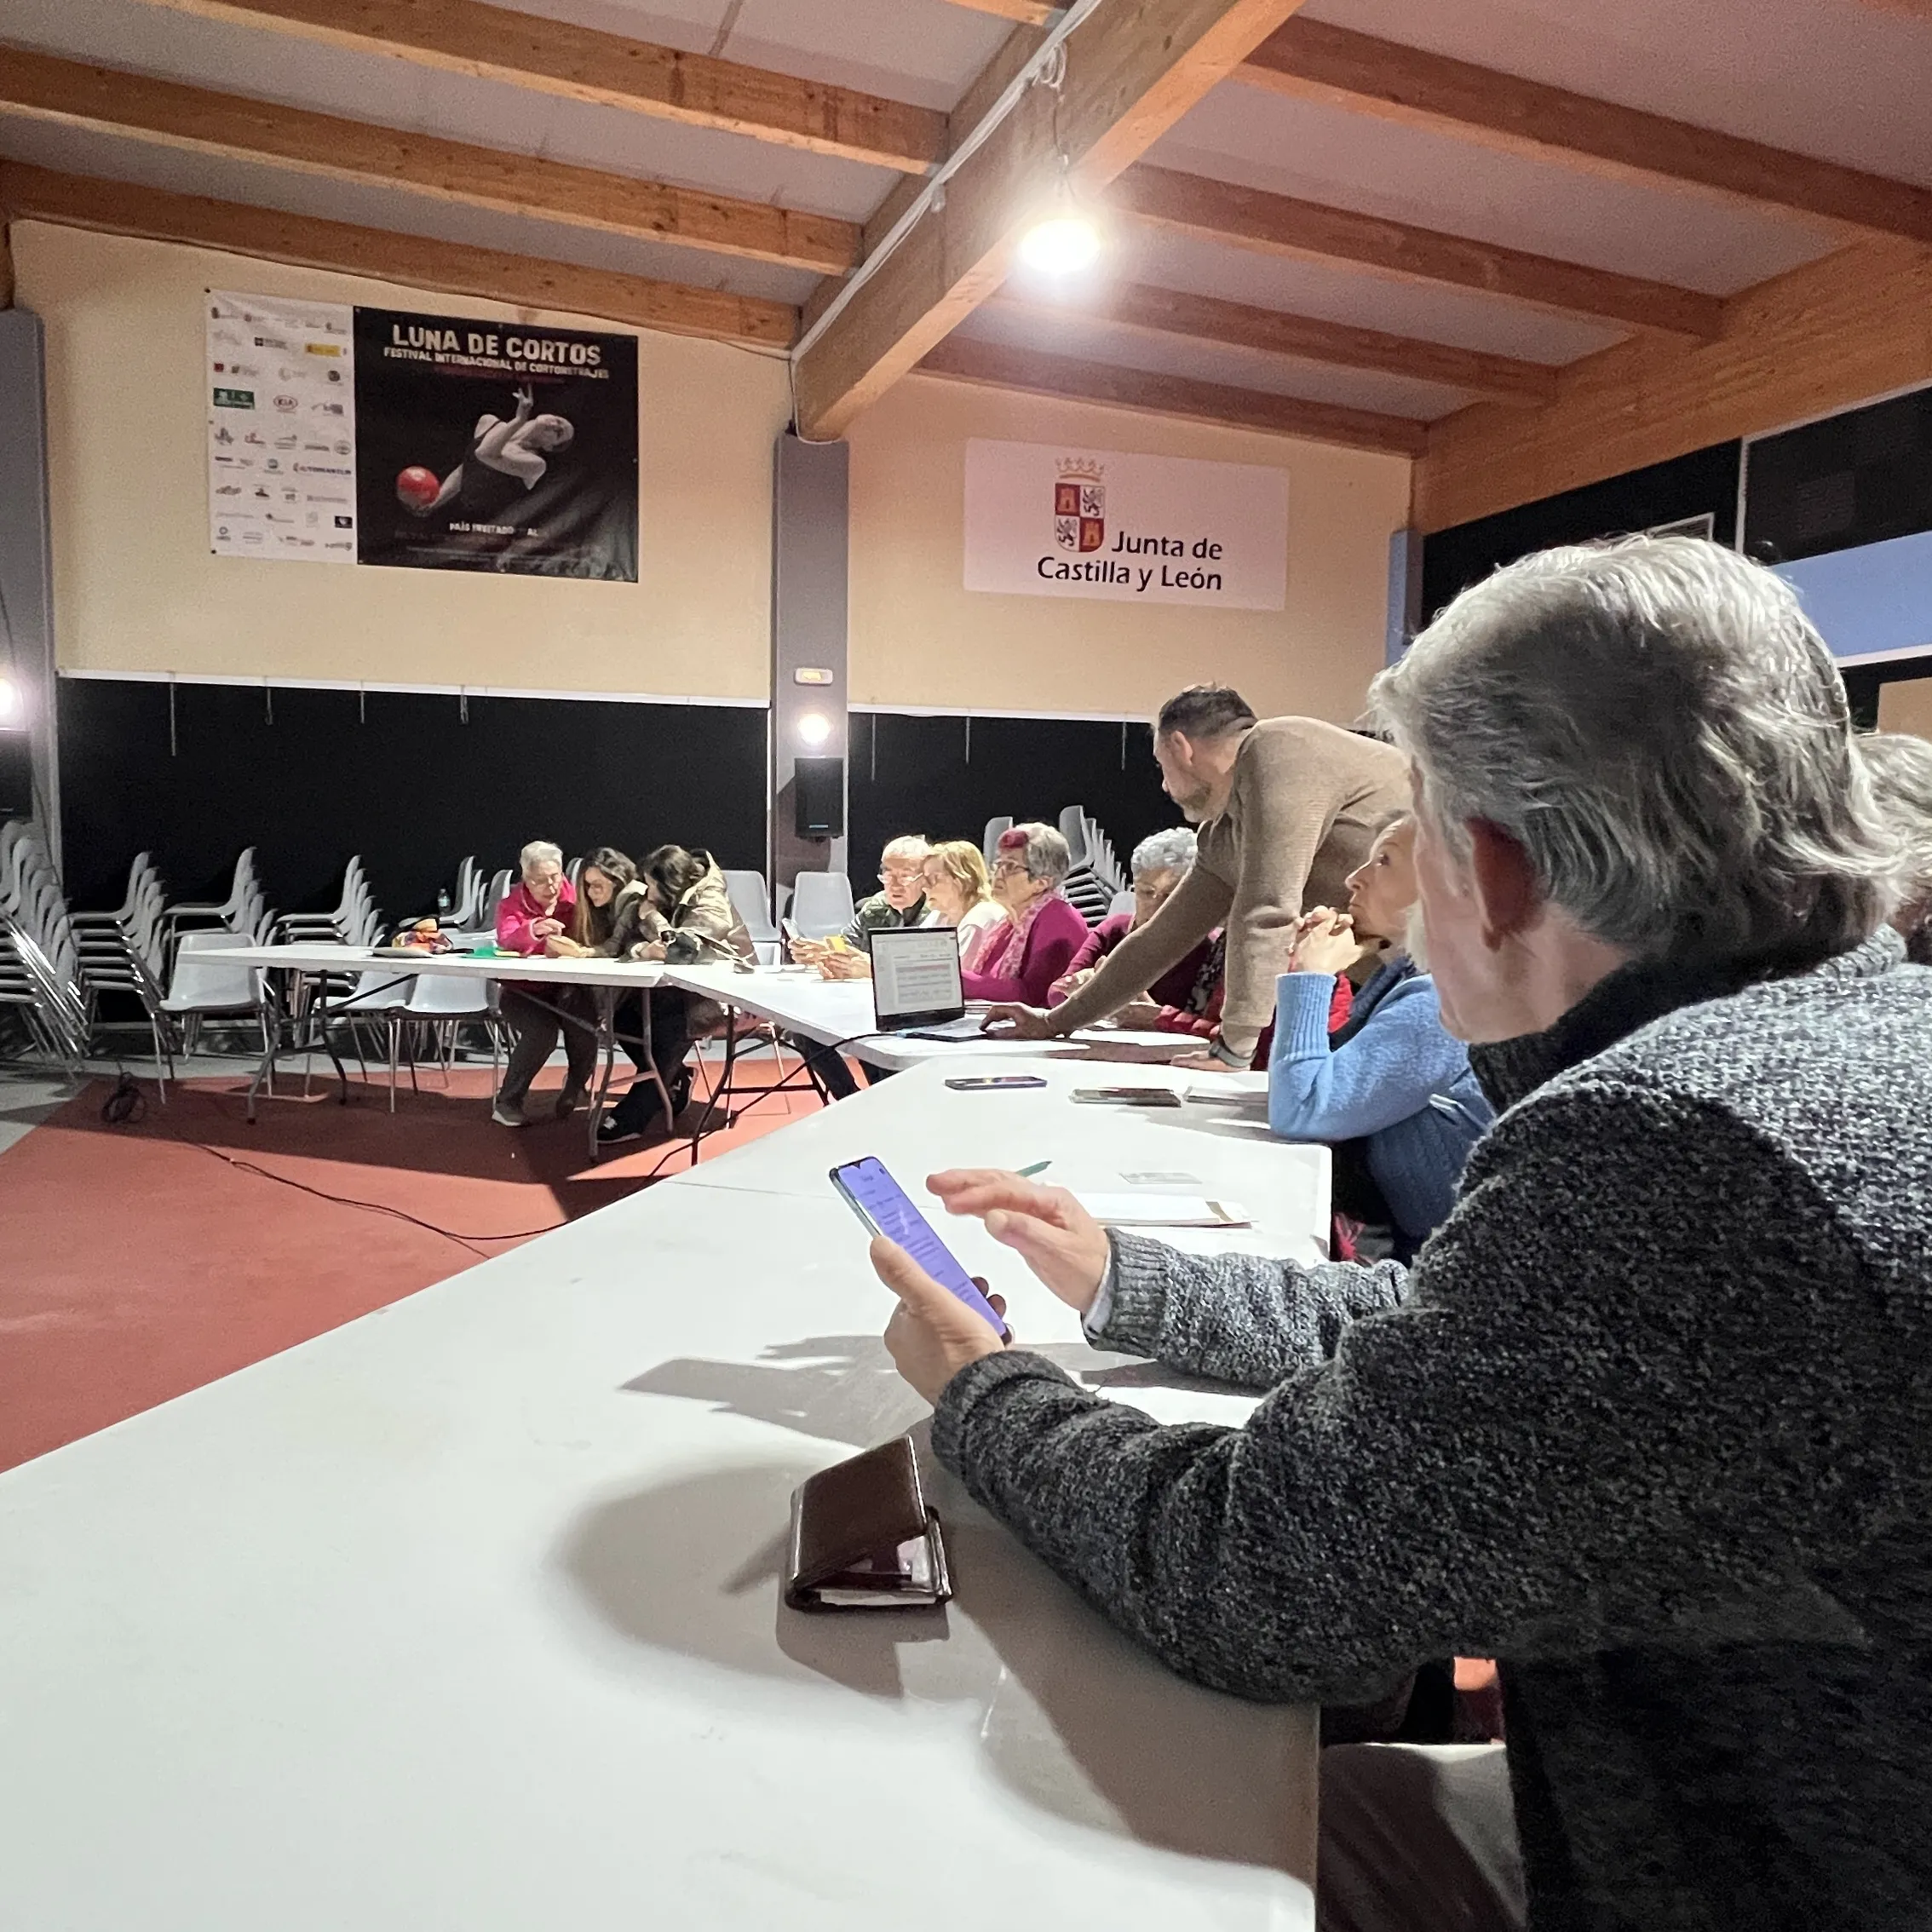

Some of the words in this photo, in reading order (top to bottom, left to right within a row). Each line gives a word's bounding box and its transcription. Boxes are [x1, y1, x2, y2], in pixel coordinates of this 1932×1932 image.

[383, 347, 432, 361] FESTIVAL
[515, 361, 527, 371] DE
[393, 325, 460, 351] LUNA
[468, 333, 498, 355] DE
[506, 337, 601, 365] CORTOS
[1112, 531, 1184, 557] Junta
[1192, 538, 1222, 560] de
[1037, 556, 1130, 584] Castilla
[1136, 568, 1153, 592] y
[1160, 565, 1222, 590] León
